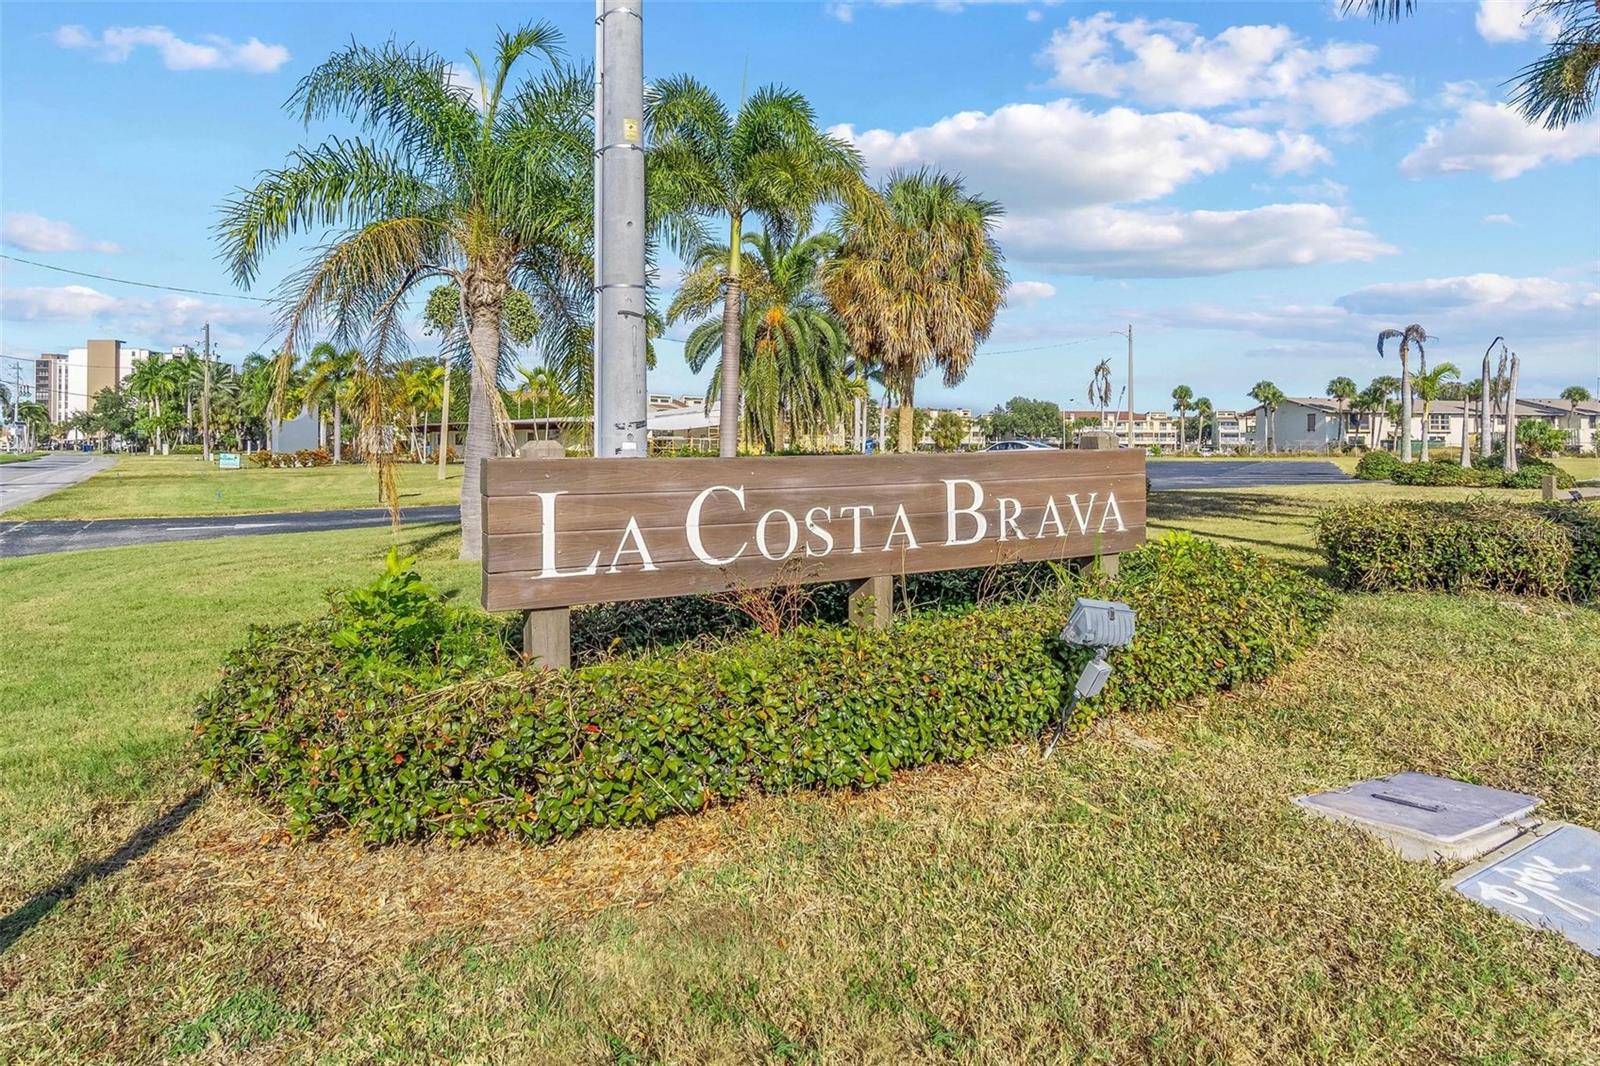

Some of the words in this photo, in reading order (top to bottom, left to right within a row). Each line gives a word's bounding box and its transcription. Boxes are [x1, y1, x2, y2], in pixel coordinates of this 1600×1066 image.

[530, 490, 660, 580] LA
[685, 484, 922, 567] COSTA
[941, 478, 1129, 547] BRAVA
